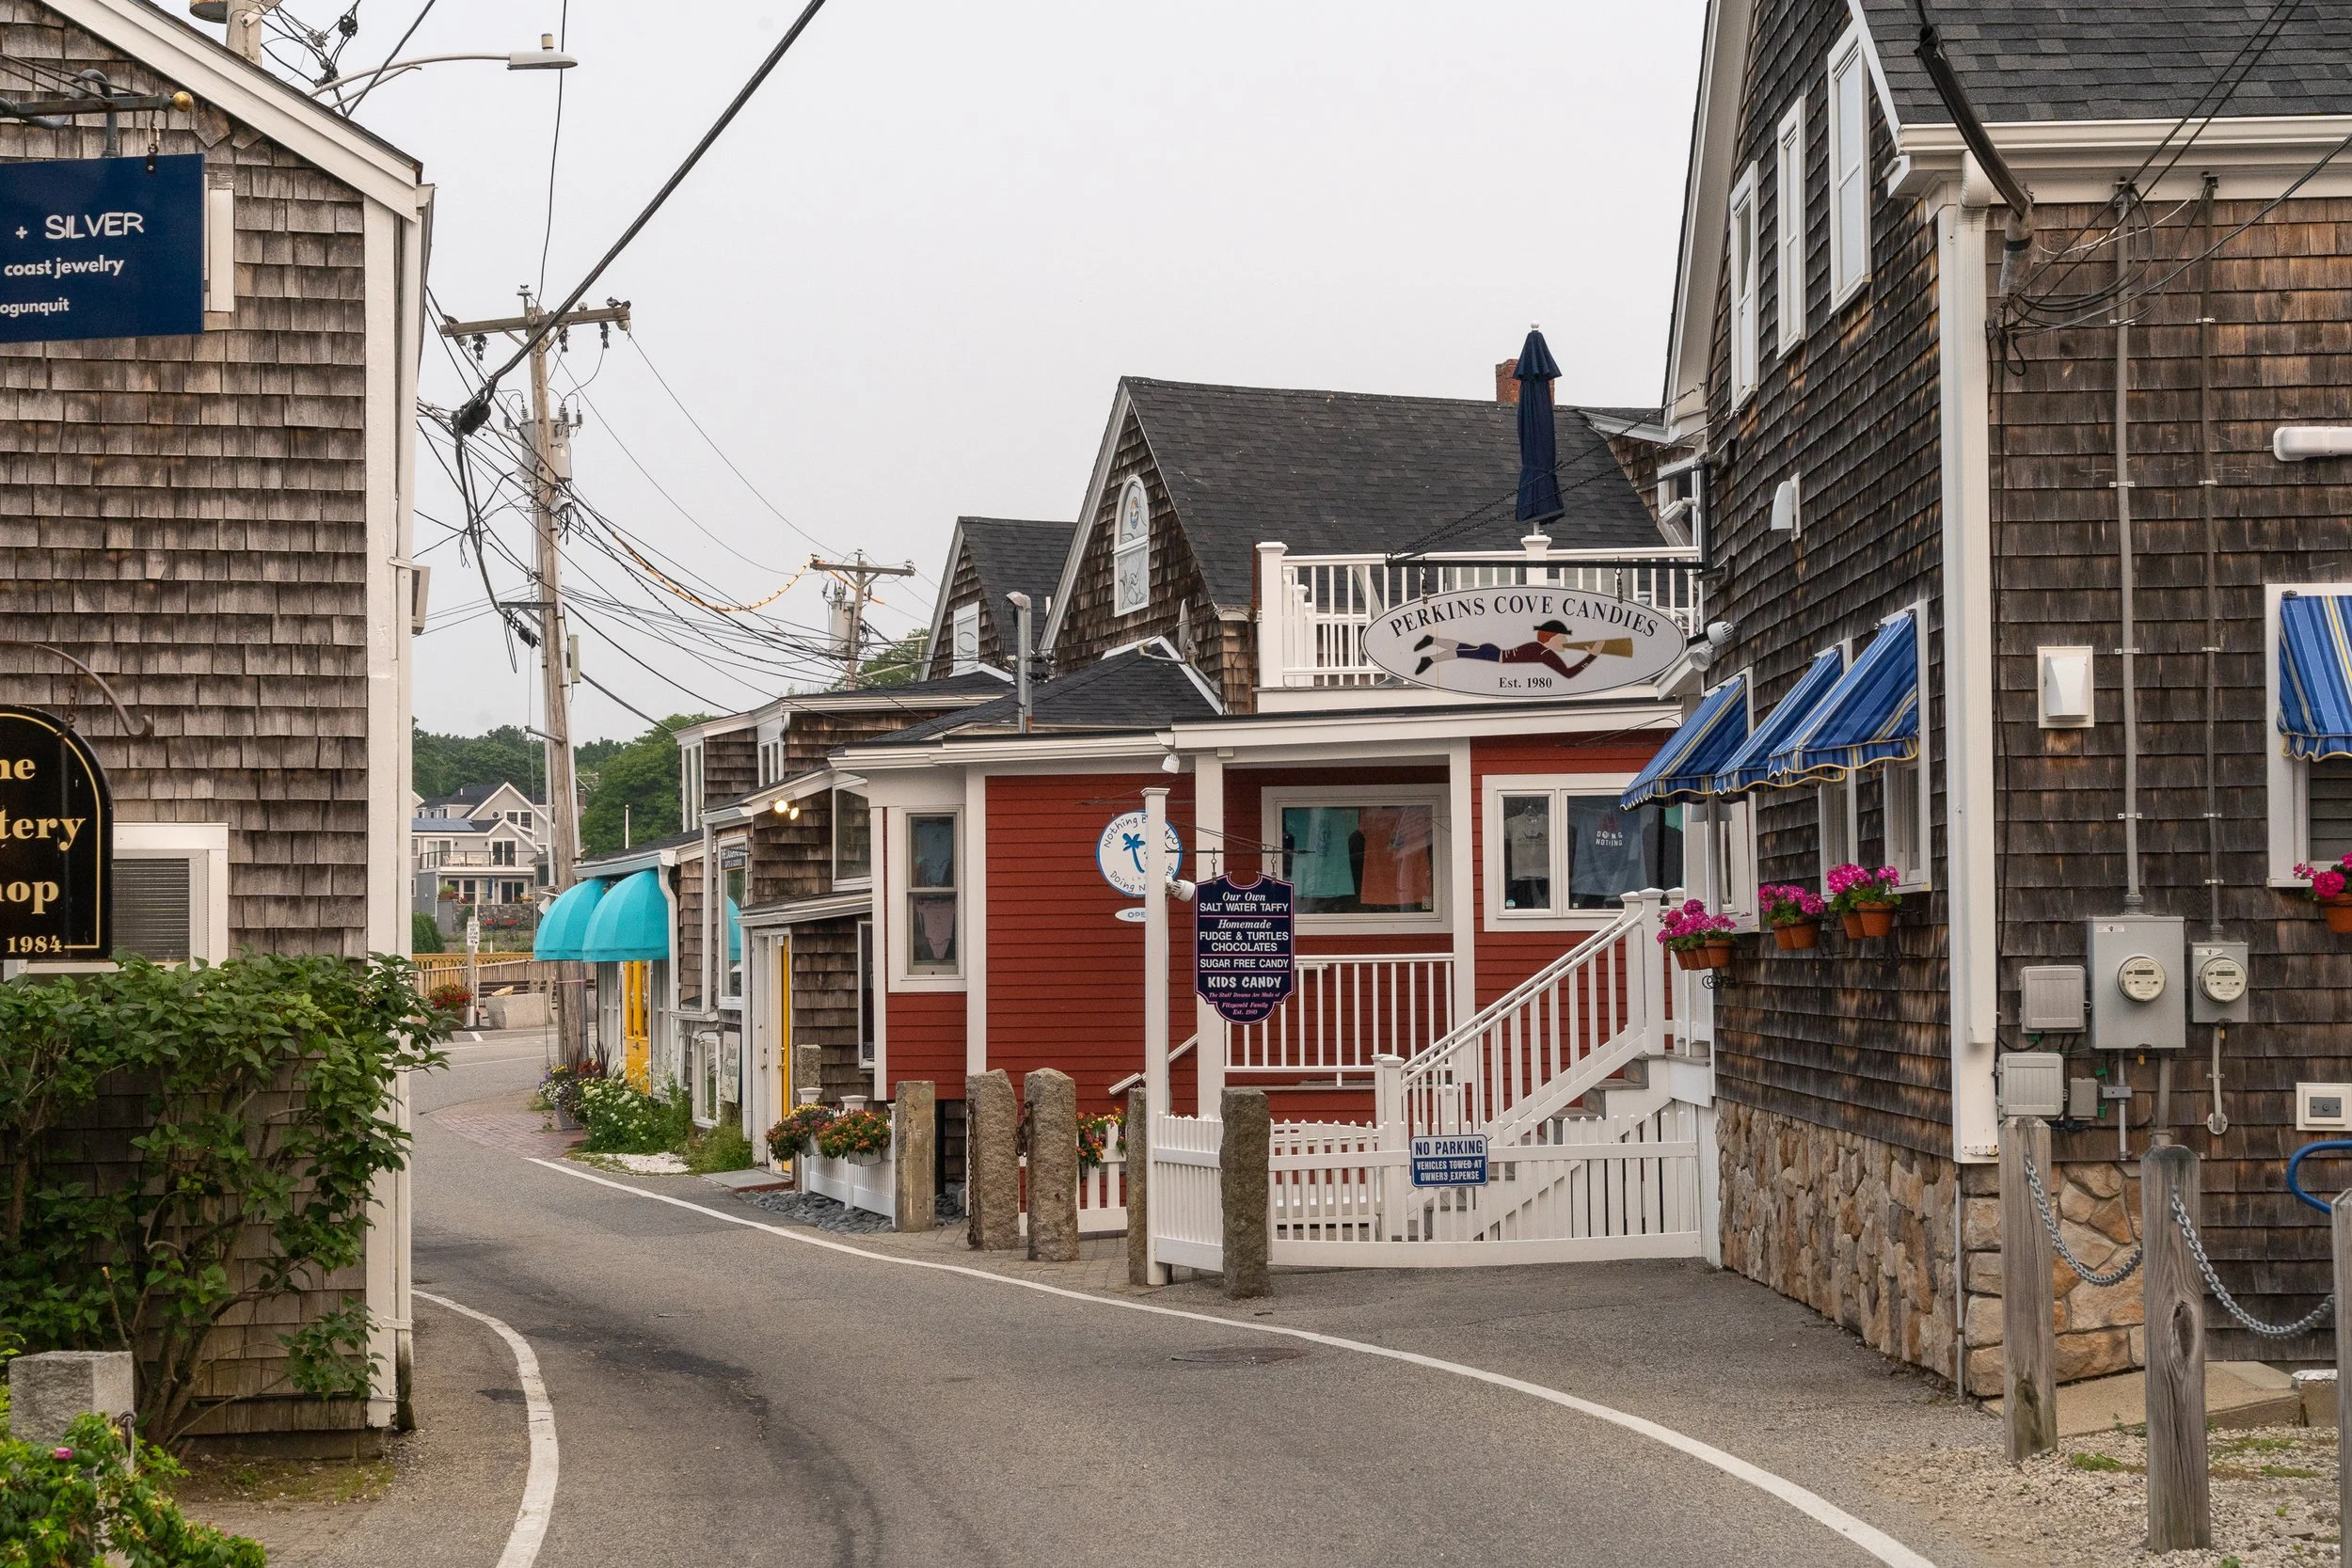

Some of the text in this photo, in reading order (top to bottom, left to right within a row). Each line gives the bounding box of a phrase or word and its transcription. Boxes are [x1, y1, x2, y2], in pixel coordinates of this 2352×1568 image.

[45, 212, 144, 240] SILVER
[4, 254, 125, 279] coast jewelry
[0, 296, 70, 318] ogunquit
[1389, 594, 1659, 639] PERKINS COVE CANDIES
[1499, 676, 1552, 689] Est. 1980
[1104, 816, 1138, 848] Nothing
[1110, 870, 1136, 893] Doing
[1222, 892, 1266, 901] Our Own
[1200, 903, 1289, 912] SALT WATER TAFFY
[1217, 919, 1272, 929] Homemade
[1200, 931, 1289, 941] FUDGE & TURTLES
[7, 934, 63, 954] 1984
[1211, 942, 1278, 952] CHOCOLATES
[1200, 958, 1289, 968] SUGAR FREE CANDY
[1207, 976, 1281, 989] KIDS CANDY
[1415, 1139, 1483, 1156] NO PARKING
[1416, 1159, 1483, 1170] VEHICLES TOWED AT
[1420, 1170, 1480, 1182] OWNERS EXPENSE
